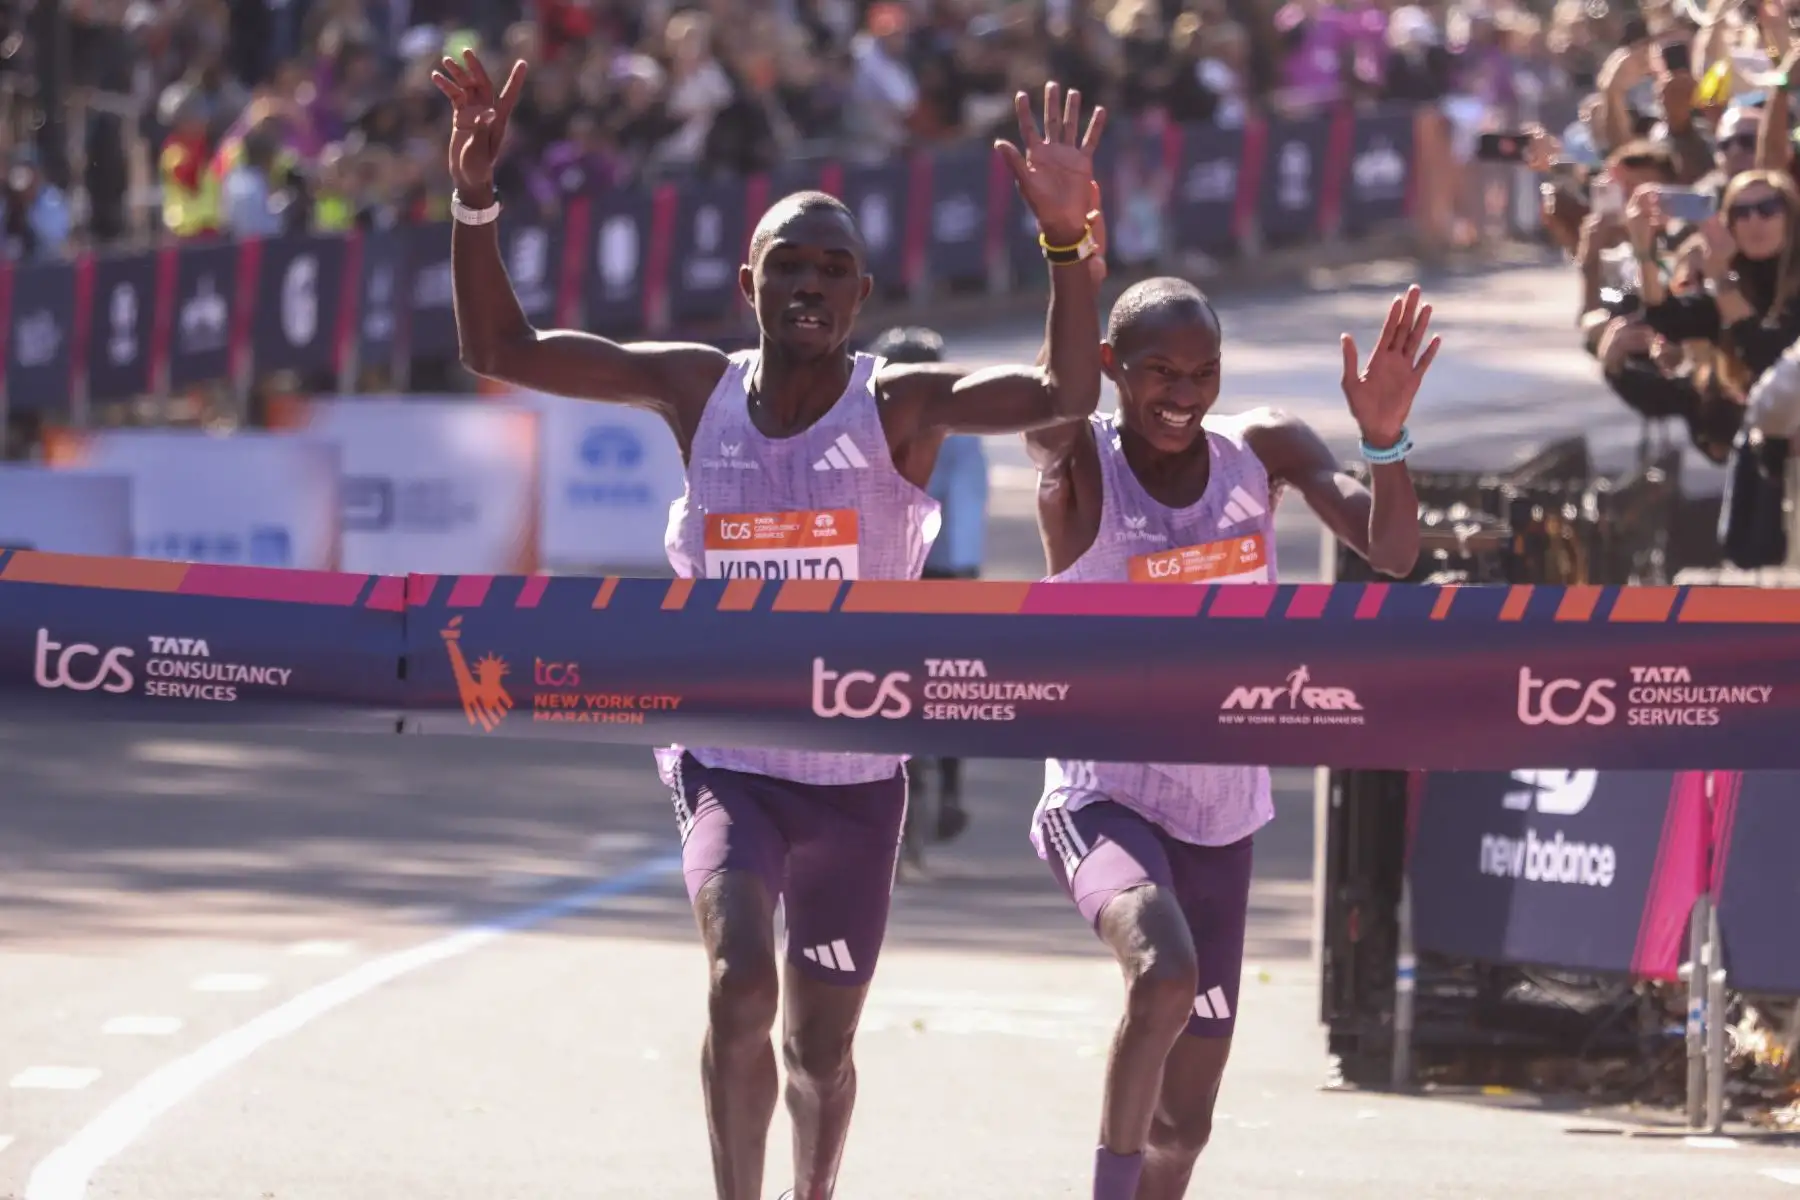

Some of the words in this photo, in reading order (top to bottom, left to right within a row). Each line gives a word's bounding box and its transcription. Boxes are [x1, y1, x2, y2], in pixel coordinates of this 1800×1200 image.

[720, 518, 751, 540] tcs
[148, 636, 210, 657] TATA
[35, 628, 135, 693] tcs
[924, 658, 988, 678] TATA
[146, 659, 292, 686] CONSULTANCY
[534, 656, 580, 687] tcs
[1629, 666, 1692, 684] TATA
[145, 681, 237, 701] SERVICES
[812, 657, 912, 718] tcs
[924, 681, 1071, 701] CONSULTANCY
[1517, 666, 1617, 725] tcs
[1628, 685, 1774, 704] CONSULTANCY
[533, 694, 579, 709] NEW
[584, 695, 635, 710] YORK
[638, 695, 682, 710] CITY
[533, 710, 645, 725] MARATHON
[923, 704, 1017, 721] SERVICES
[1218, 715, 1245, 725] NEW
[1247, 715, 1276, 725] YORK
[1279, 715, 1311, 725] ROAD
[1313, 715, 1366, 725] RUNNERS
[1627, 707, 1721, 726] SERVICES
